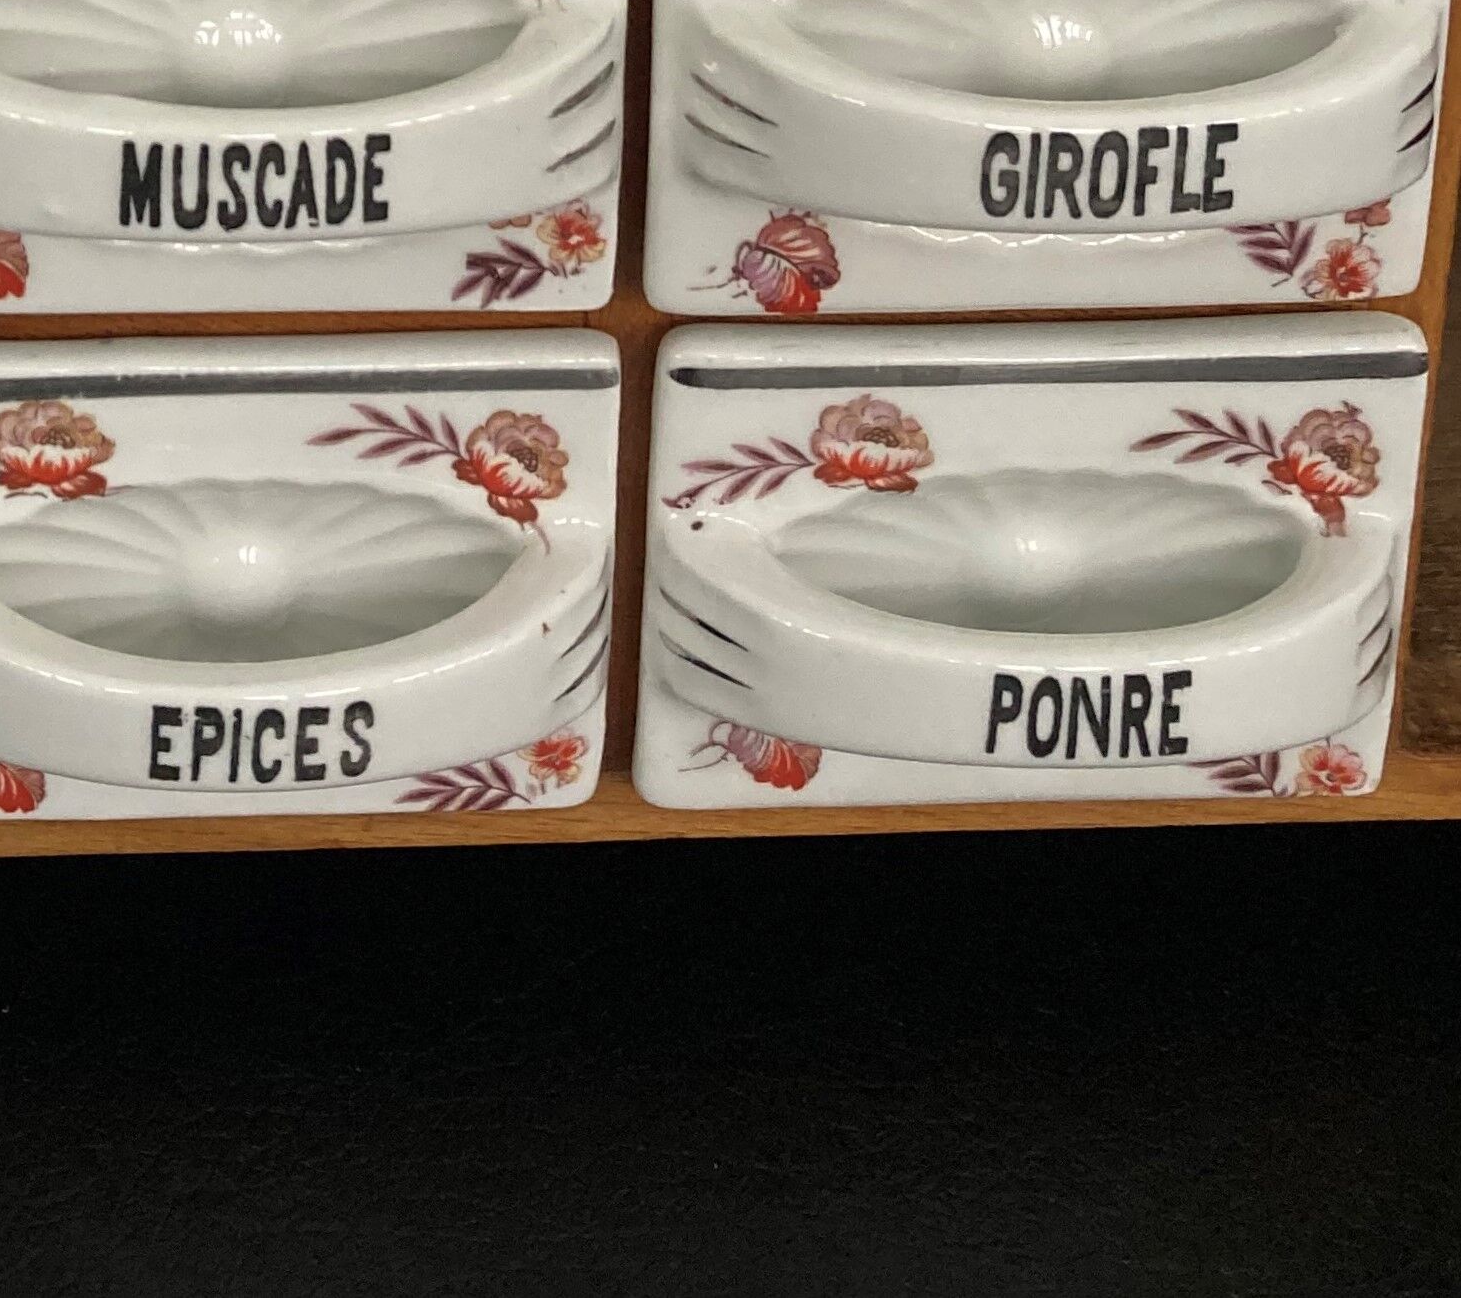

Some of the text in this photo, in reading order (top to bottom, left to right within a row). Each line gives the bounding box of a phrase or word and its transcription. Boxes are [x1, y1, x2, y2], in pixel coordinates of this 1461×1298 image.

[119, 134, 393, 232] MUSCADE
[980, 123, 1239, 220] GIROFLE
[148, 700, 375, 784] EPICES
[985, 670, 1193, 760] PONRE
